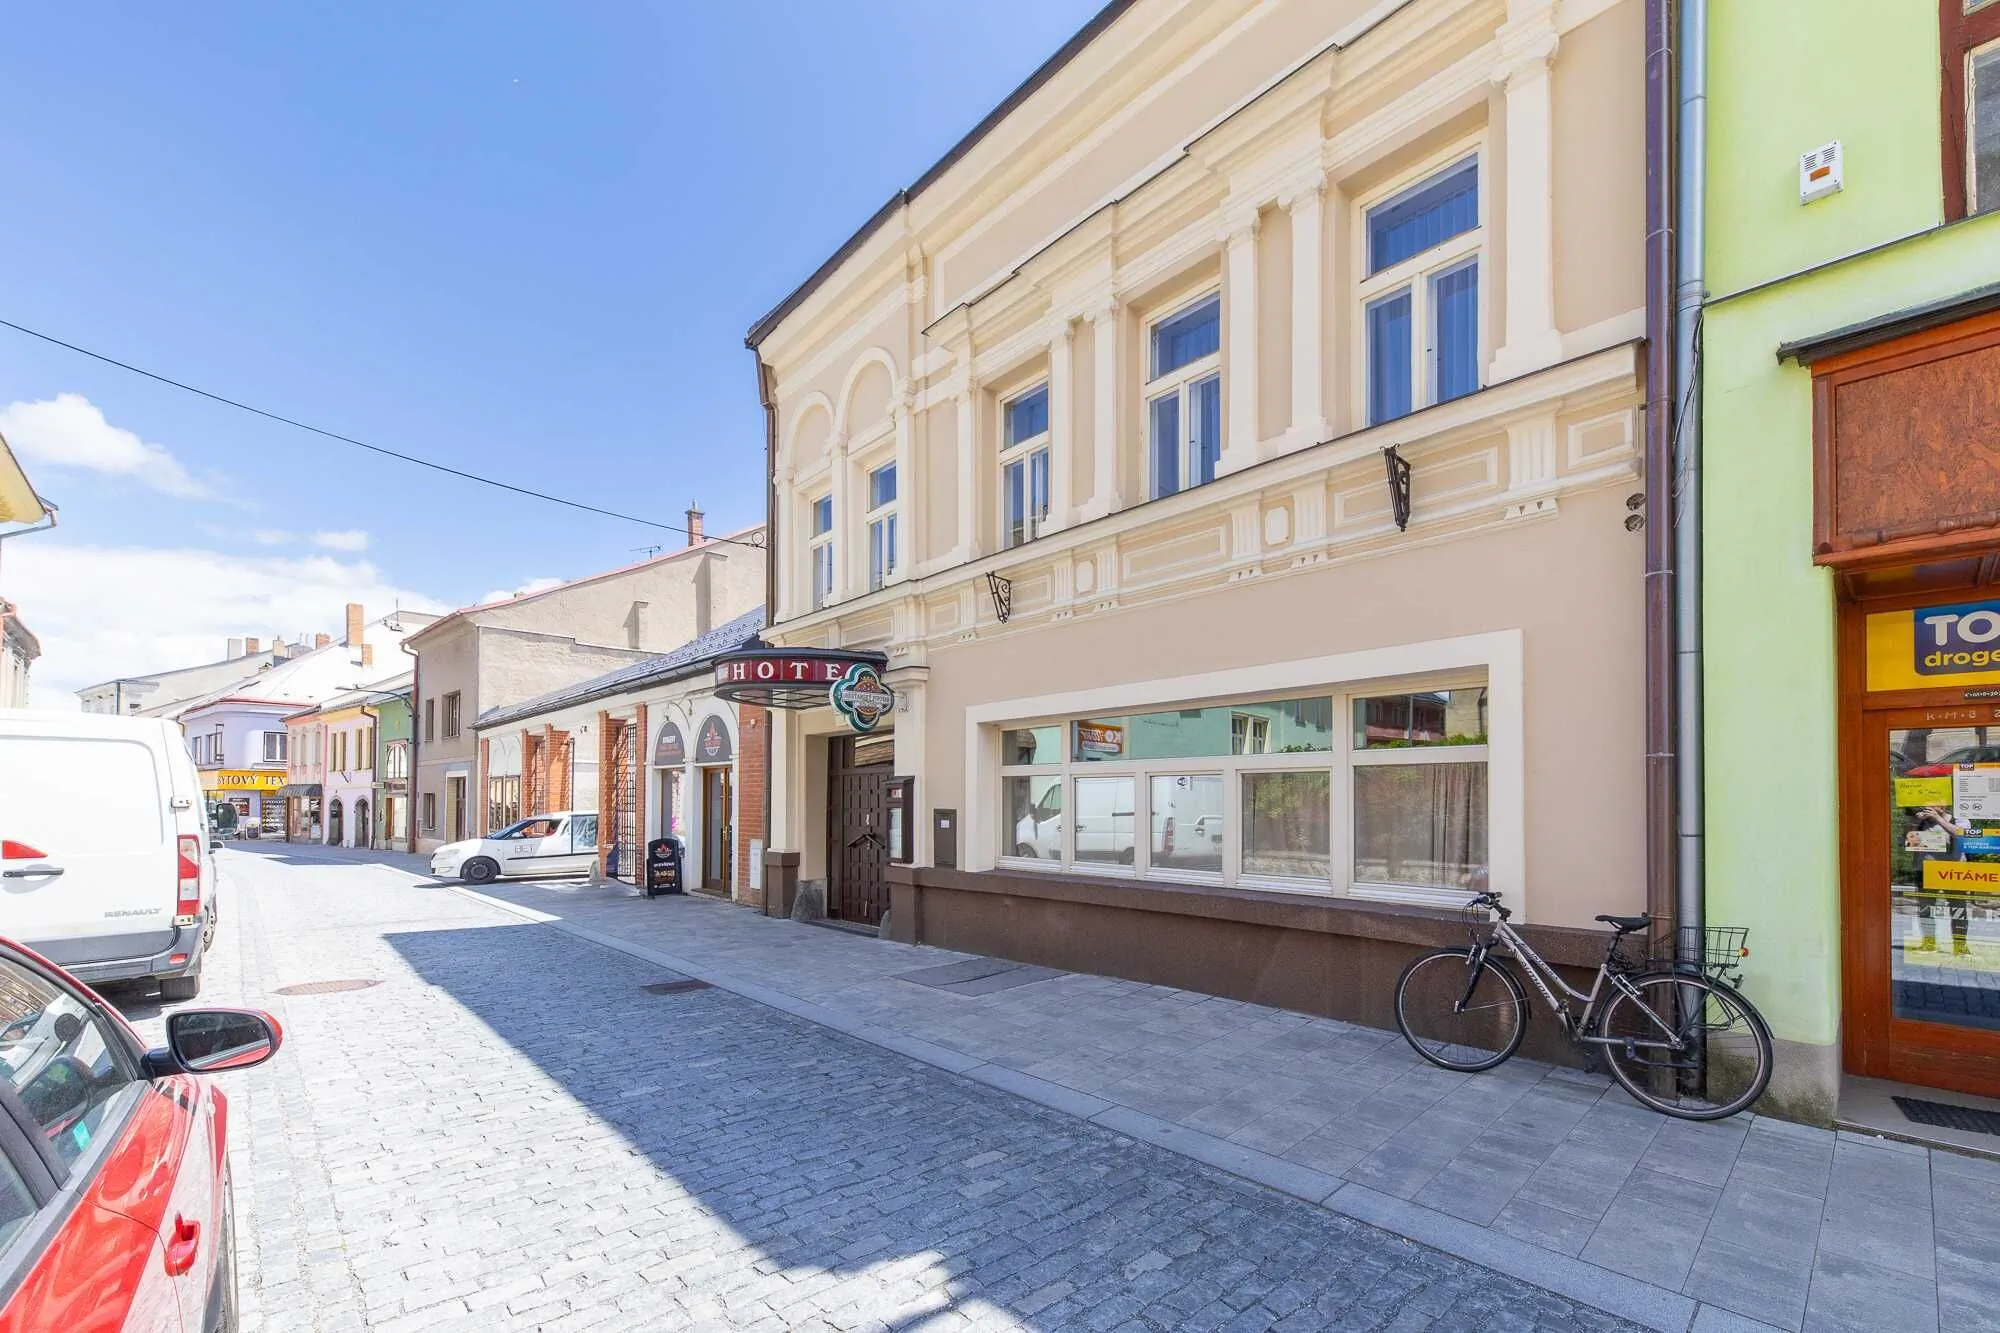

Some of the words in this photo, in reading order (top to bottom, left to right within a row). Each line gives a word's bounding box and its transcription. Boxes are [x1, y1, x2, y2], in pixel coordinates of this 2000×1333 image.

[1924, 611, 2000, 646] TO
[1924, 650, 2000, 667] droge
[732, 661, 842, 680] HOTE
[263, 775, 288, 785] TEX
[1938, 869, 1999, 882] VÍTÁME
